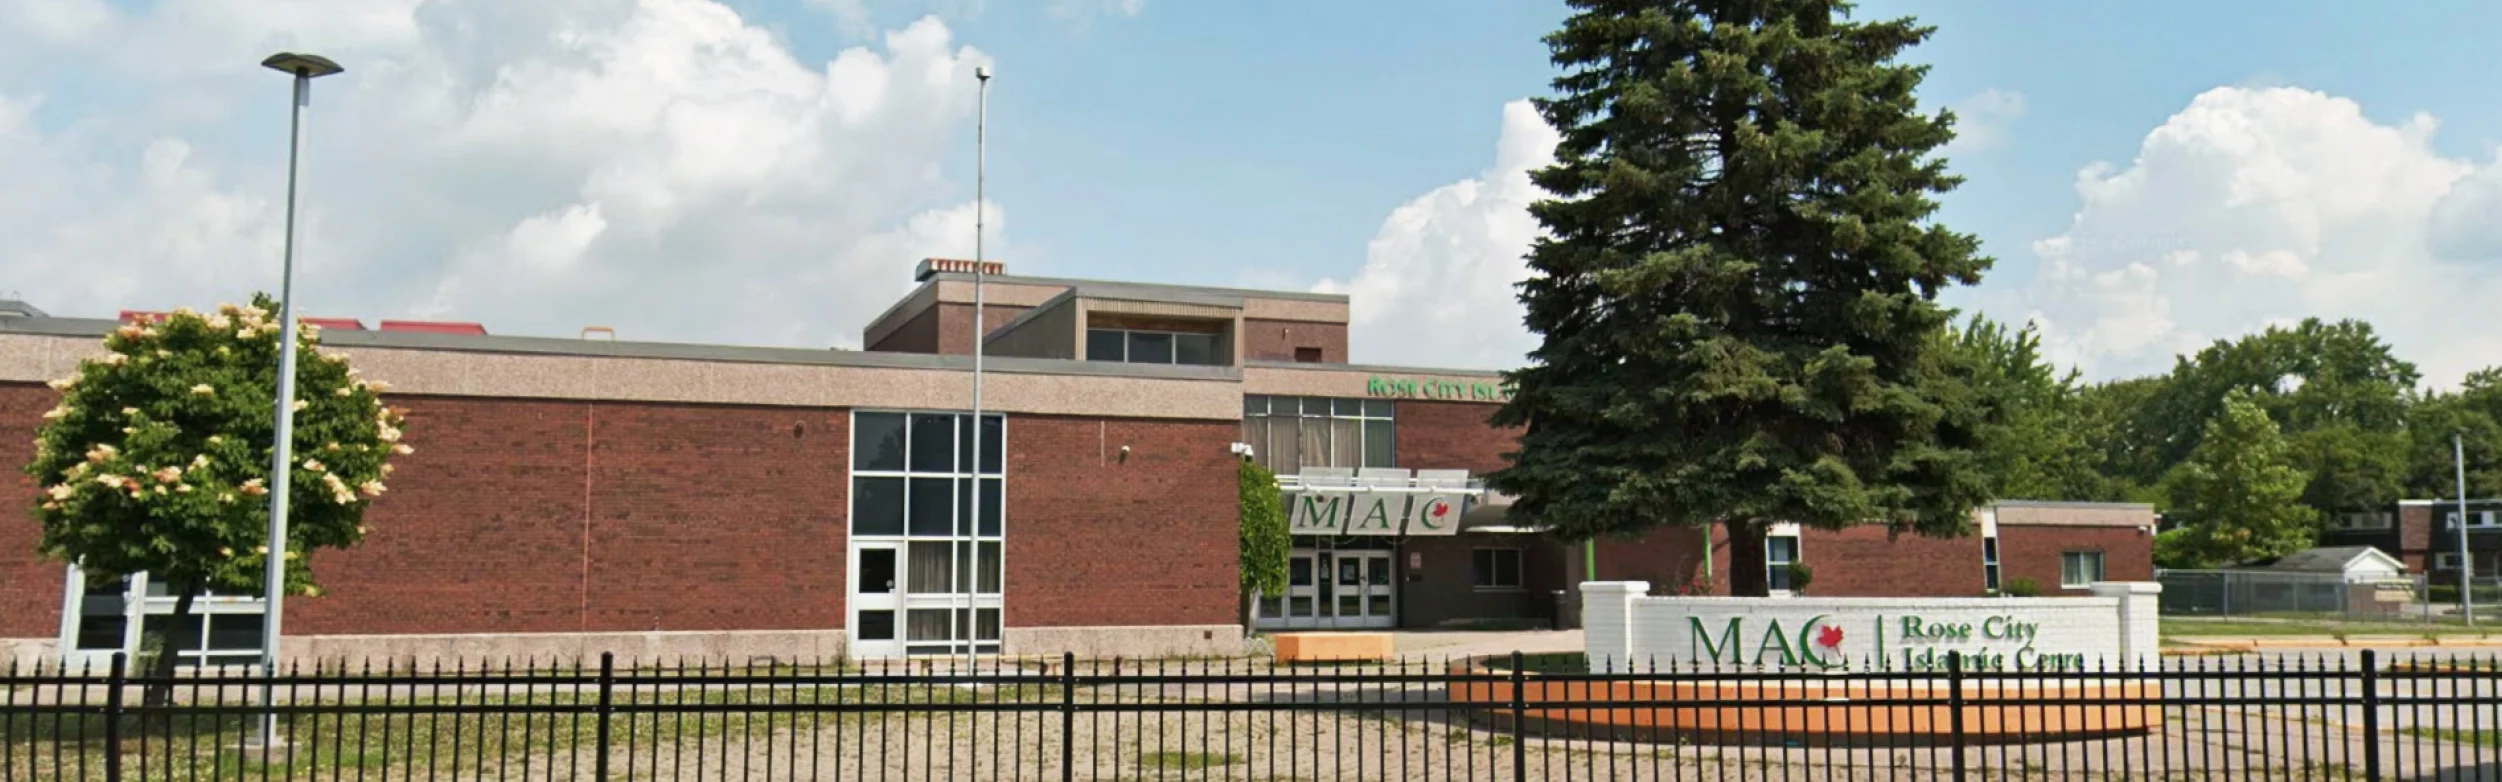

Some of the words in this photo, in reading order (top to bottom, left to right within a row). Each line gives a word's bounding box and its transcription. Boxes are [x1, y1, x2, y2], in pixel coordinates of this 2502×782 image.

[1685, 614, 1846, 668] MAC
[1901, 615, 1972, 639] Rose
[1982, 615, 2038, 646] City
